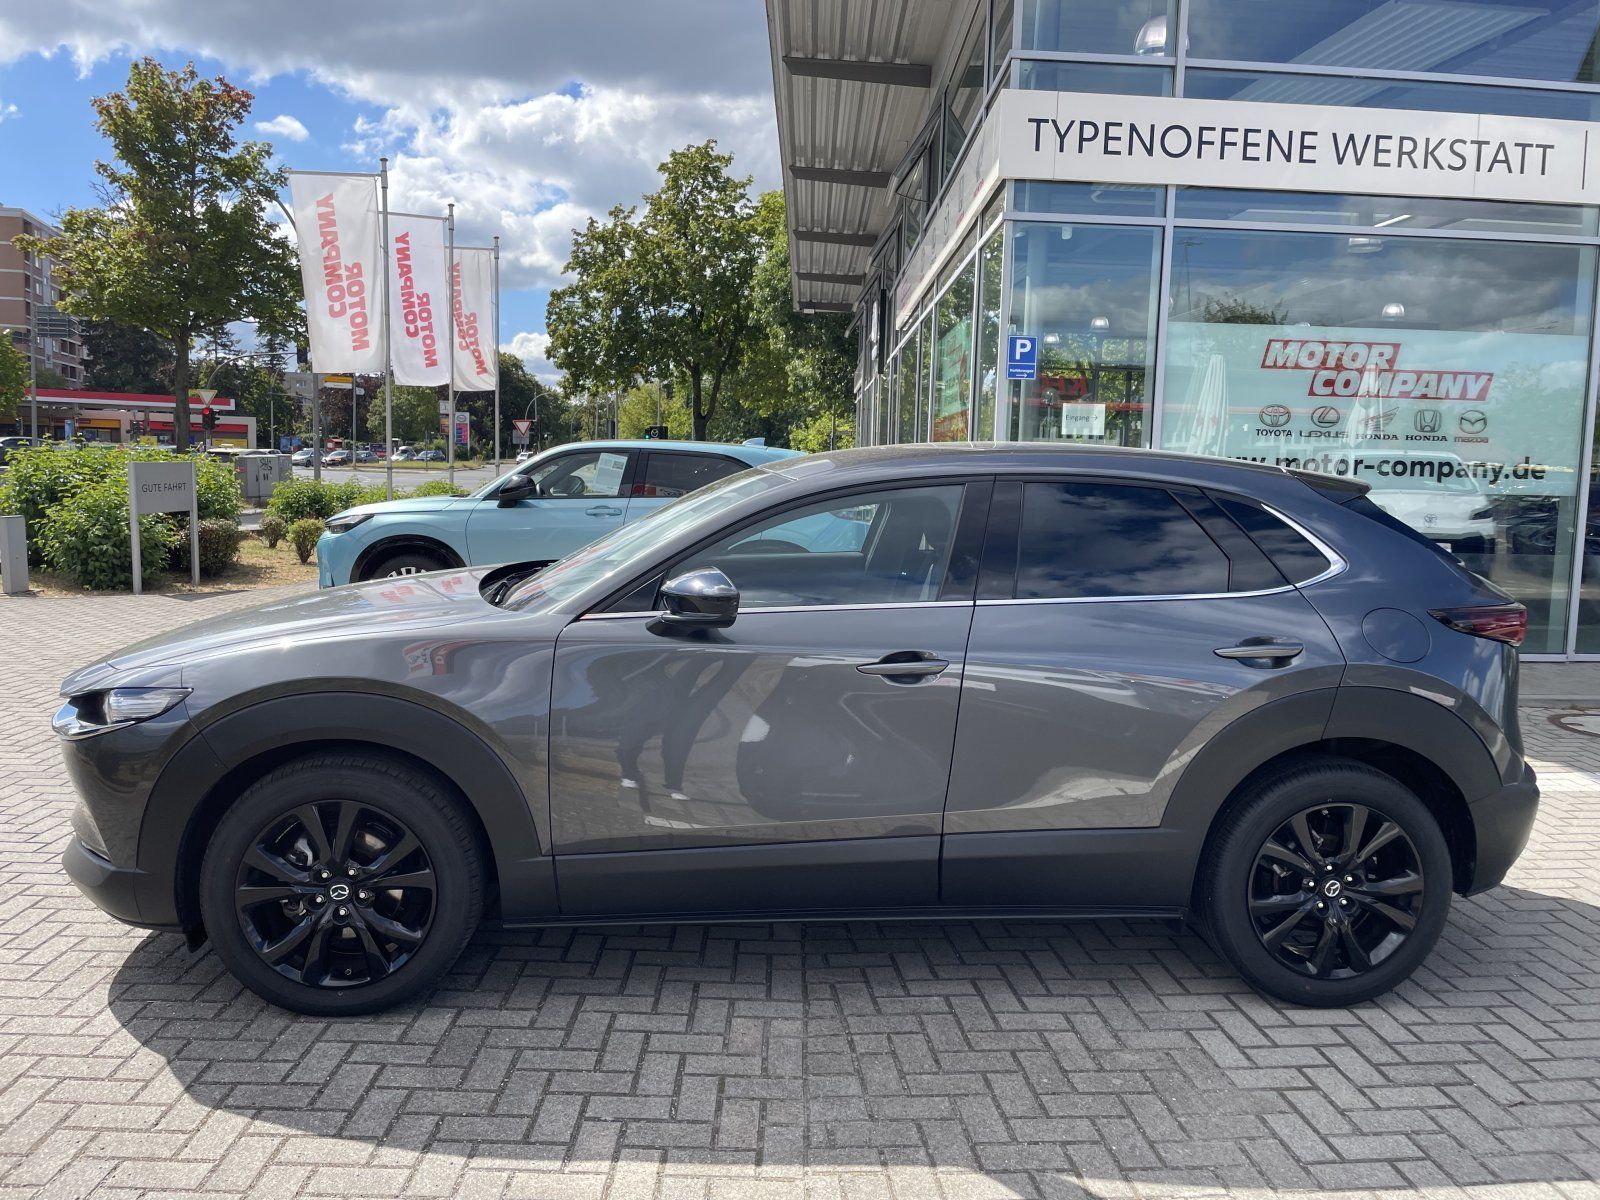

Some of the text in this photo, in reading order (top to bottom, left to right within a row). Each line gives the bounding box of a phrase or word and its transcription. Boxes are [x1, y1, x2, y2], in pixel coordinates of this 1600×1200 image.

[1028, 117, 1555, 176] TYPENOFFENE WERKSTATT
[1015, 339, 1032, 360] P
[1265, 340, 1395, 369] MOTOR
[1313, 370, 1492, 399] COMPANY
[1065, 414, 1090, 422] Eingang
[1255, 428, 1293, 438] TOYOTA
[1299, 430, 1349, 438] LEXUS
[1356, 433, 1399, 441] HONDA
[1405, 434, 1448, 442] HONDA
[141, 482, 187, 493] GUTE FAHRT
